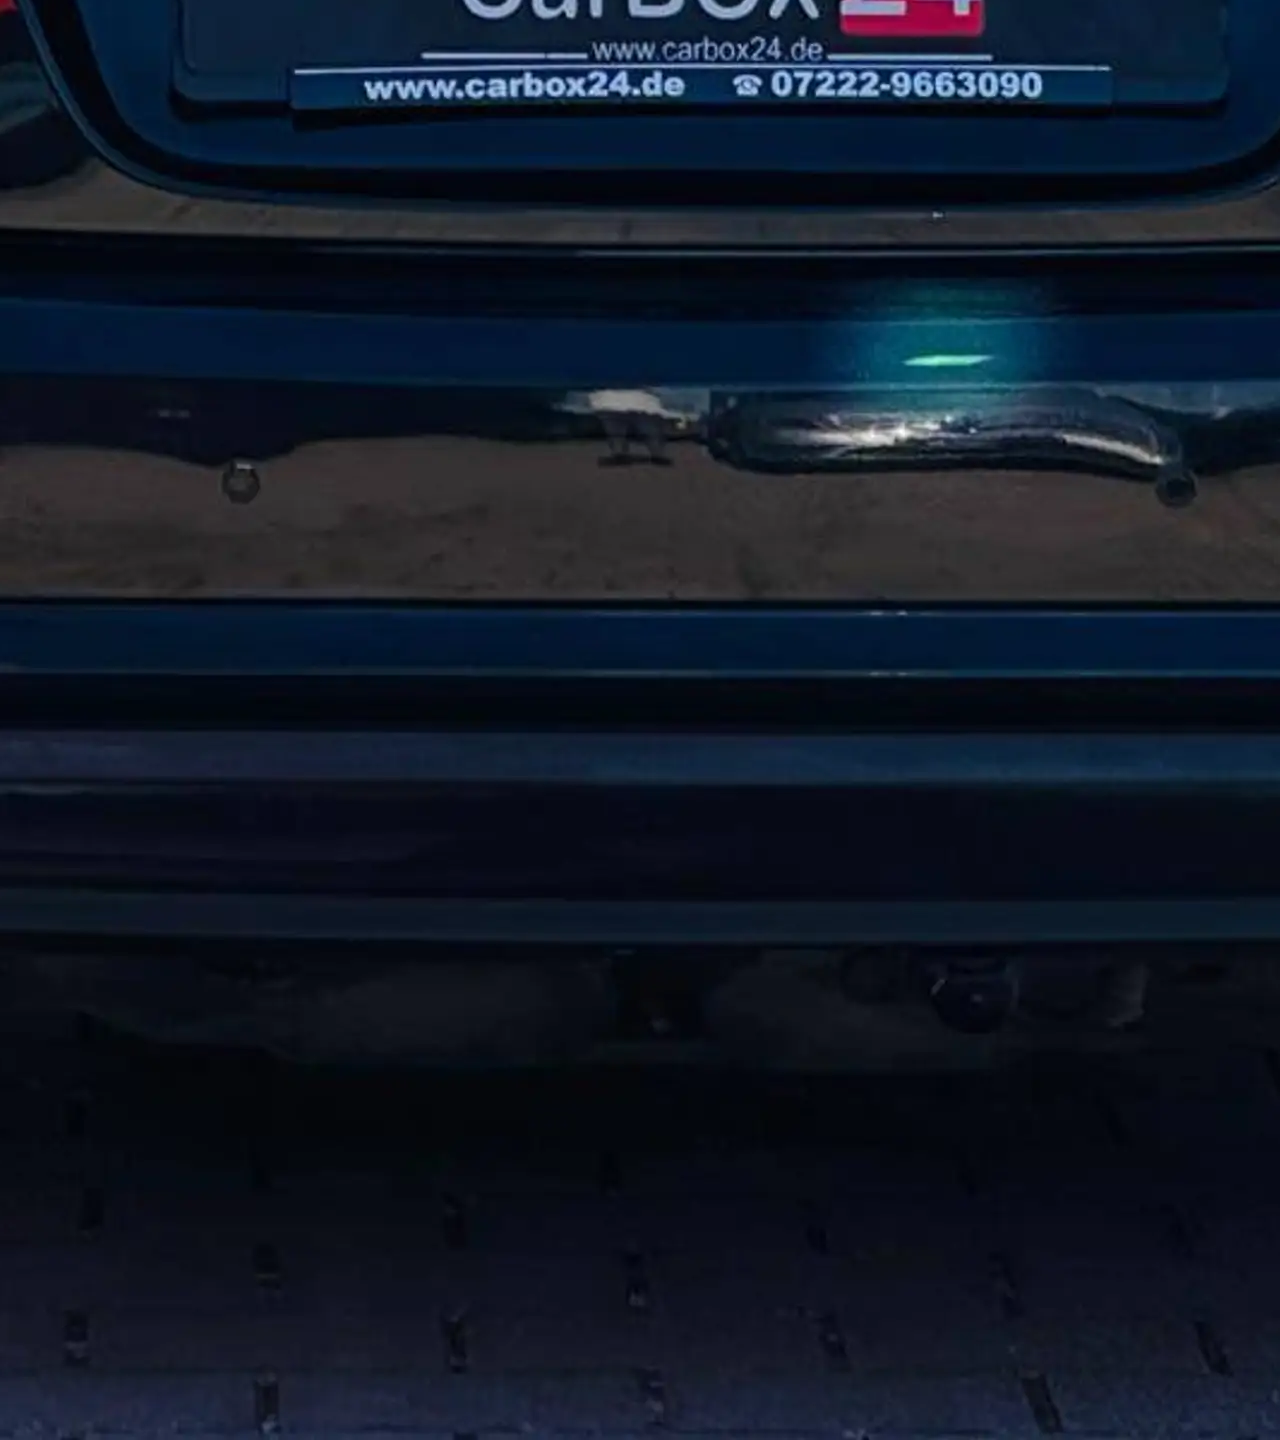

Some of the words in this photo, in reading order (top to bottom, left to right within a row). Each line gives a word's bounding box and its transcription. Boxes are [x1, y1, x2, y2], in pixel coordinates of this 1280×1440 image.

[592, 35, 823, 61] www.carbox24.de
[363, 71, 686, 100] www.carbox24.de
[770, 70, 1044, 99] 07222-9663090
